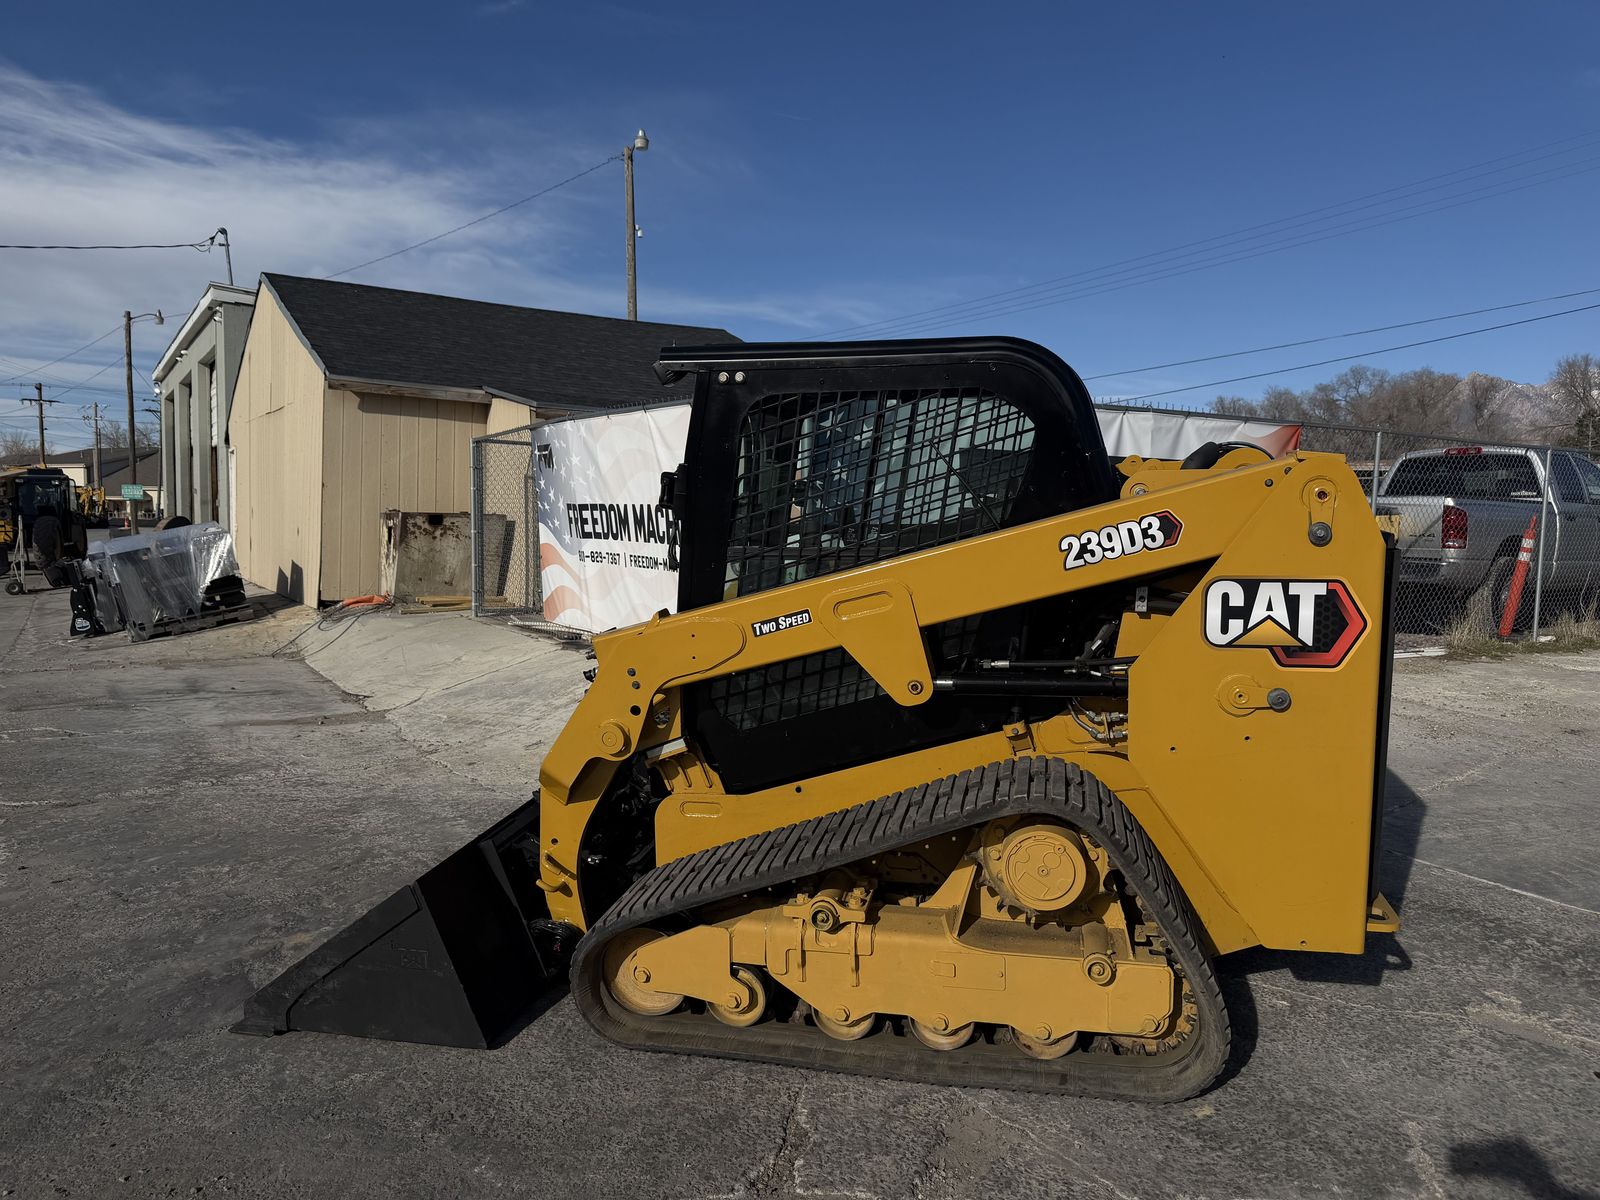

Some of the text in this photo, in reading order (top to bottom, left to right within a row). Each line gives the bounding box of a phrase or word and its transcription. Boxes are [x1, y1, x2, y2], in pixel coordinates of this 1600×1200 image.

[566, 503, 631, 542] FREEDOM
[1060, 515, 1166, 569] 239D3
[1205, 580, 1328, 647] CAT
